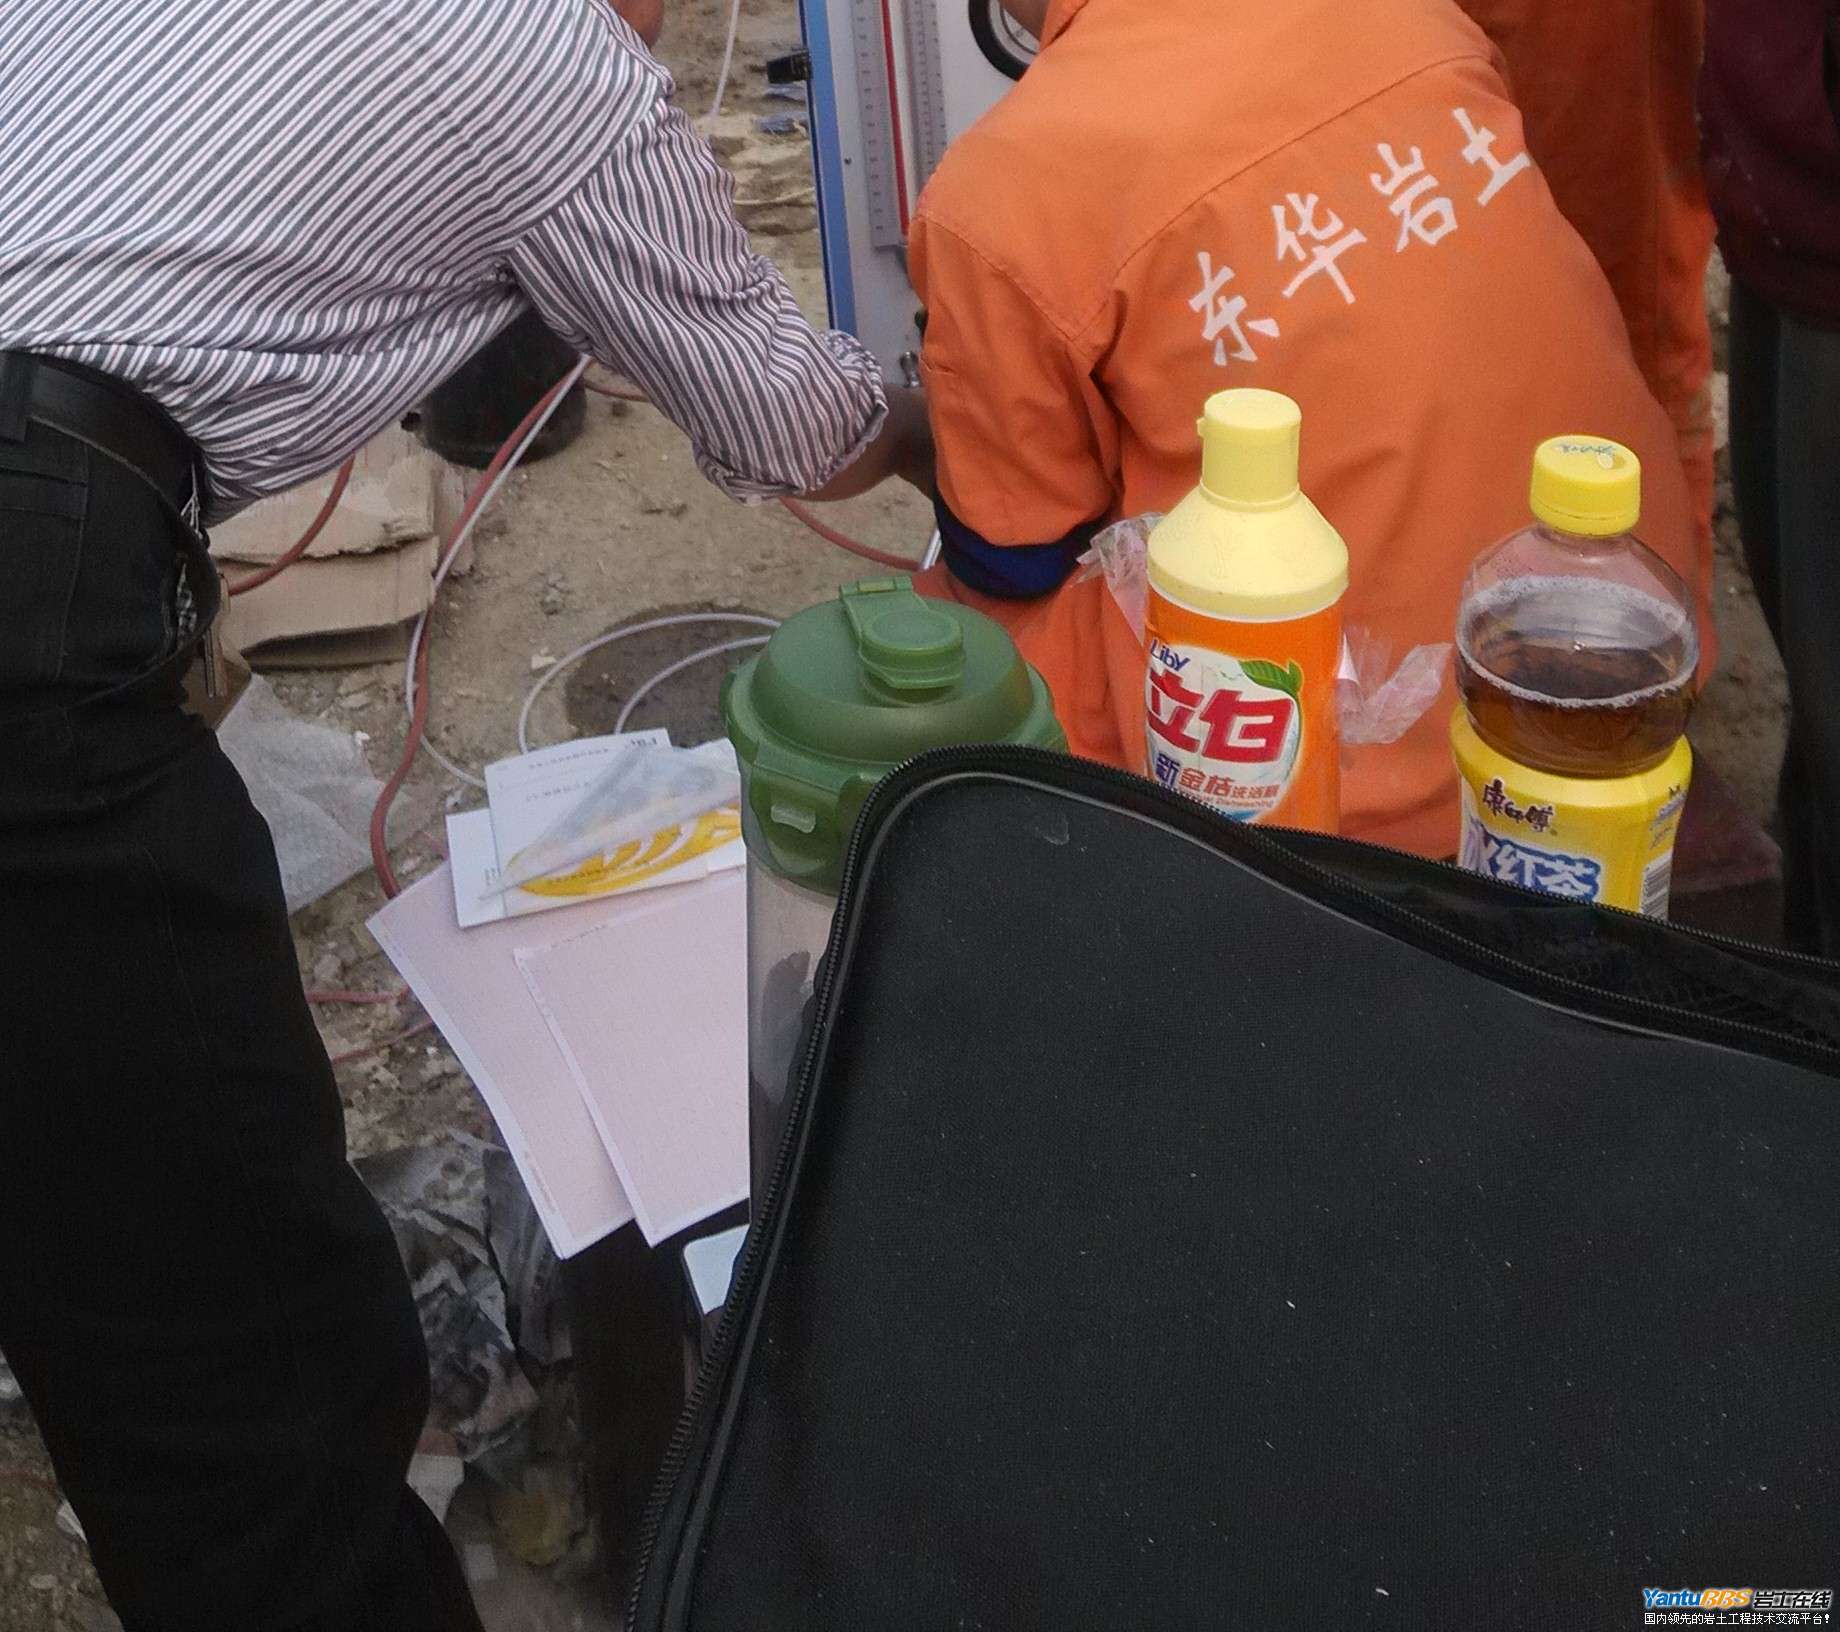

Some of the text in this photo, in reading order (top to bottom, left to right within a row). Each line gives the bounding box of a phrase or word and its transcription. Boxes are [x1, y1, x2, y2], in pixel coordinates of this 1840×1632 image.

[1188, 107, 1531, 366] 东华岩土
[1150, 638, 1190, 671] Liby
[1147, 667, 1294, 764] 立白
